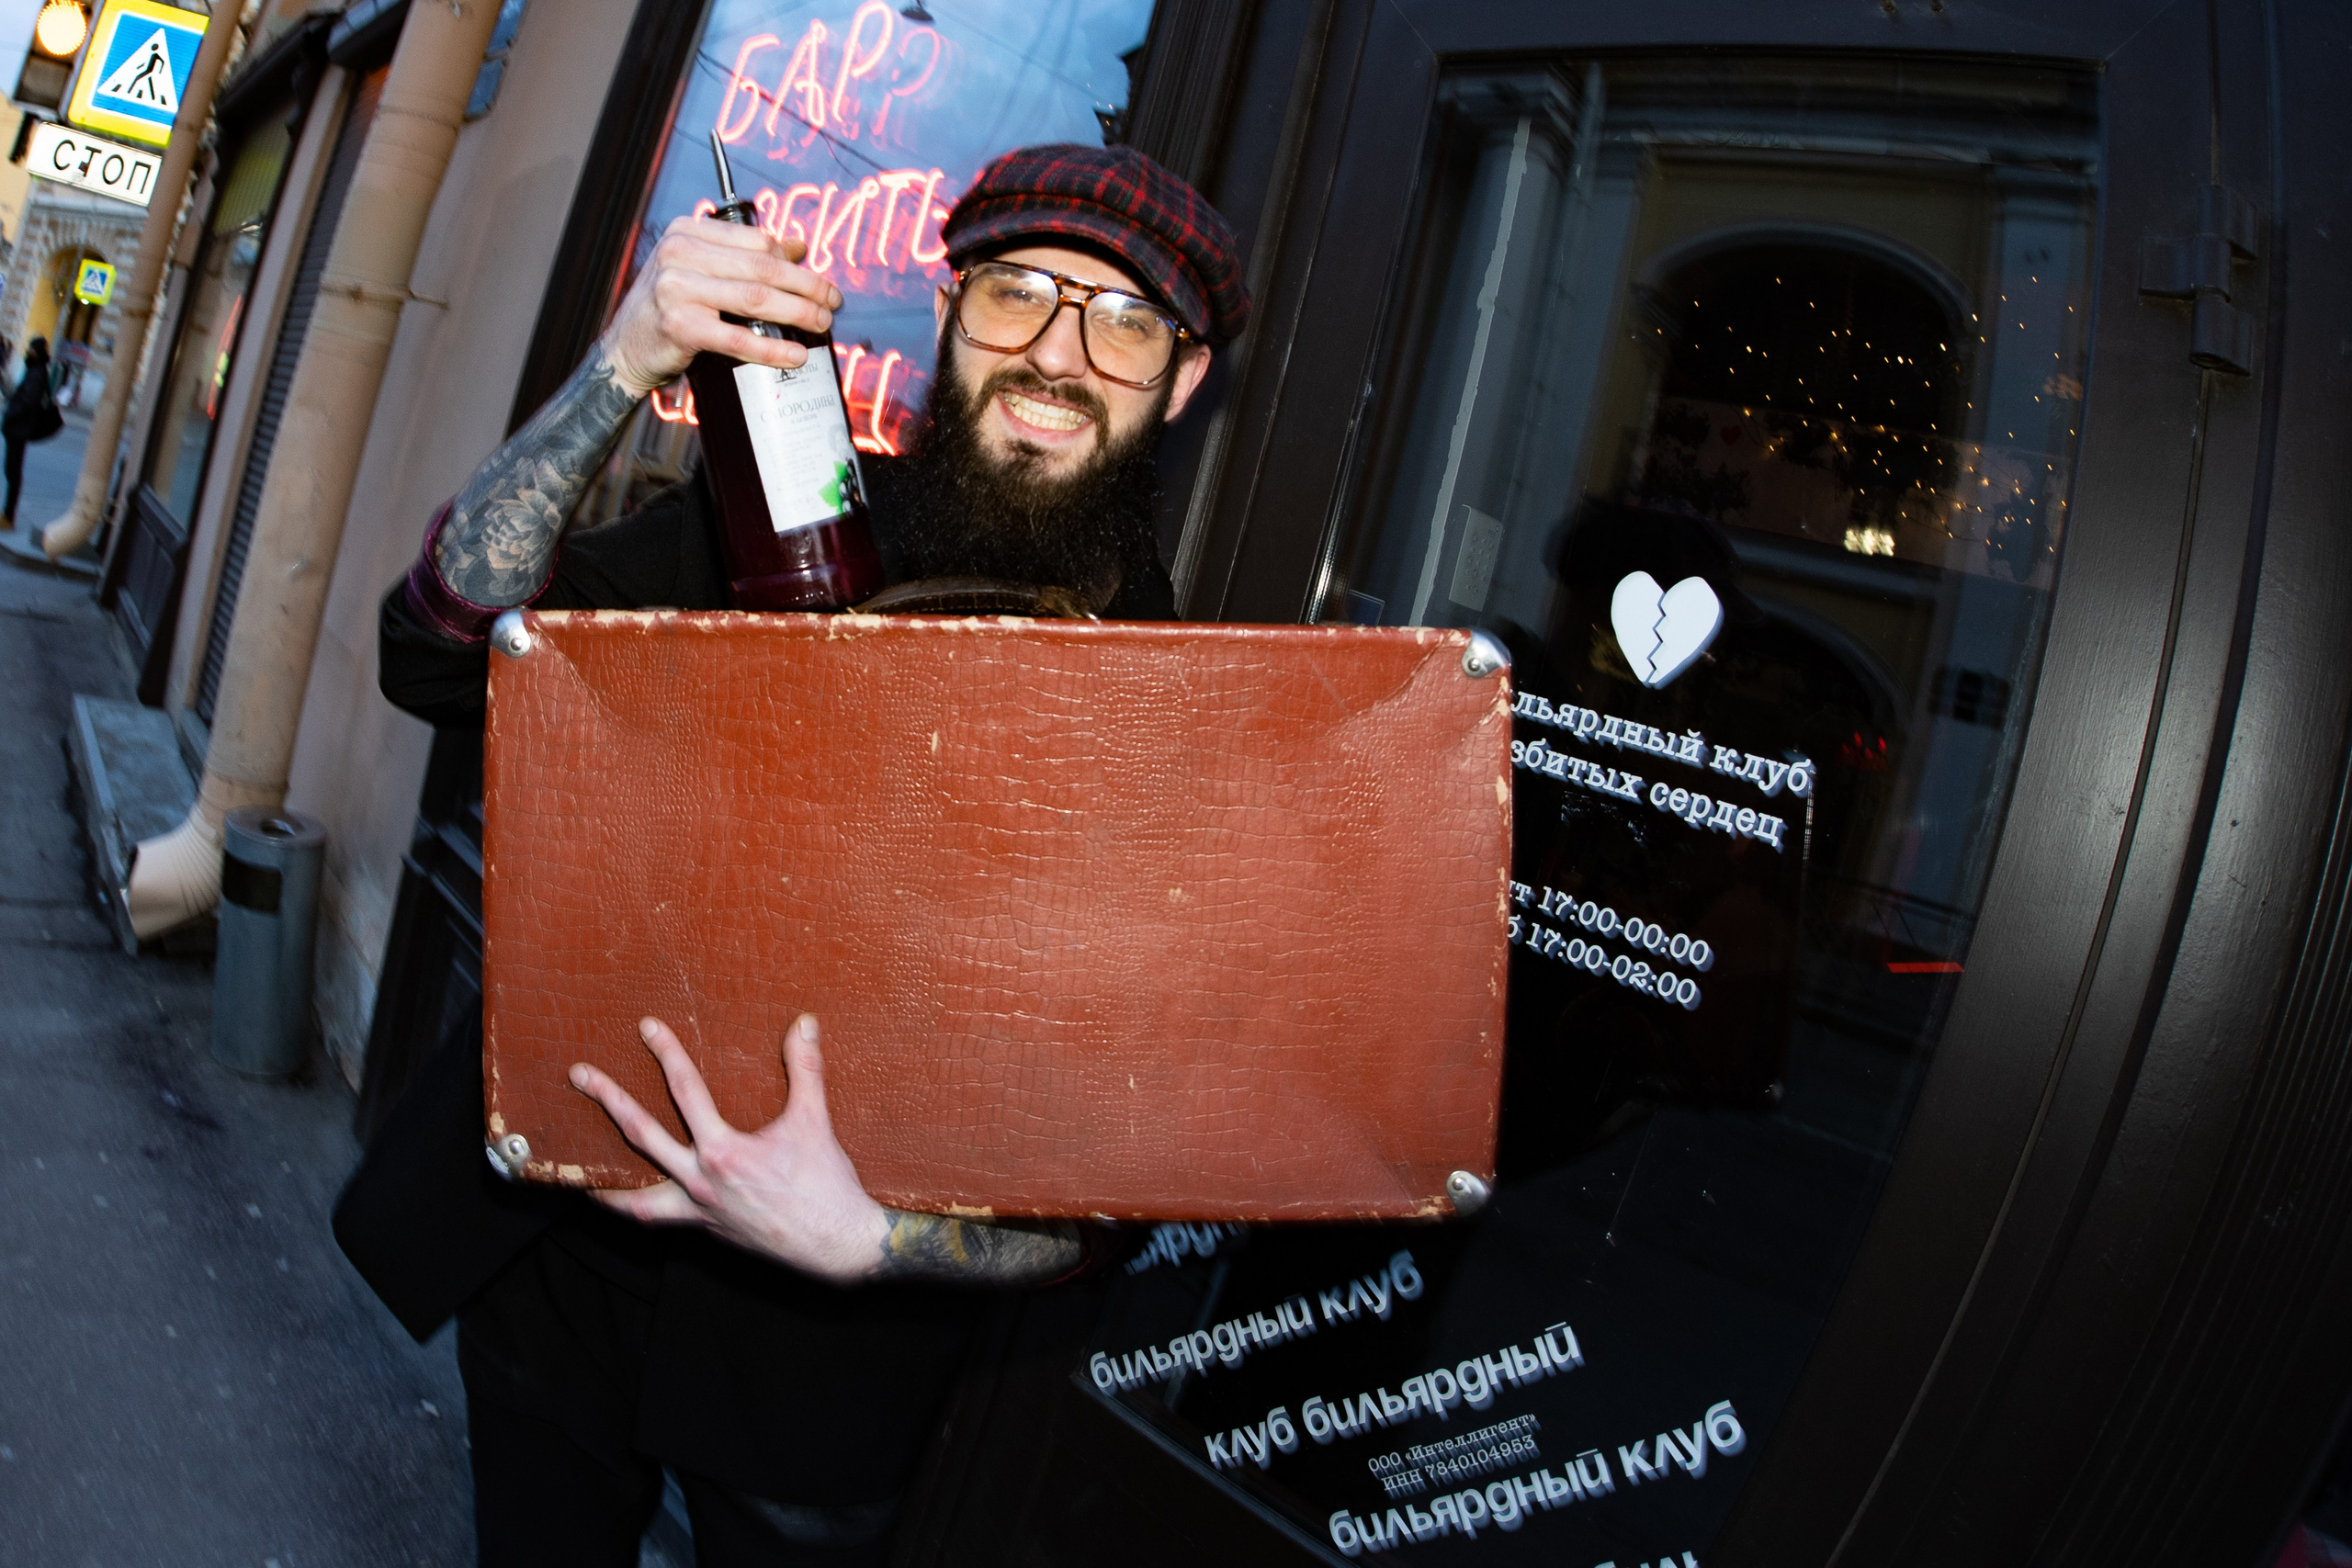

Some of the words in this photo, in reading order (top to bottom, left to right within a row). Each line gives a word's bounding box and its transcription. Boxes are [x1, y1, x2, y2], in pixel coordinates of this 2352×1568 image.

[53, 140, 152, 194] СТОП
[1510, 689, 1703, 763] льярдный
[1710, 745, 1812, 793] клуб
[1510, 739, 1643, 798] збитых
[1650, 782, 1783, 847] сердец
[1525, 922, 1697, 1005] 17:00-02:00
[1537, 886, 1710, 965] 17:00-00:00
[1090, 1293, 1314, 1390] бильярдный
[1320, 1250, 1423, 1319] клуб
[1204, 1405, 1295, 1463] клуб
[1302, 1321, 1580, 1437] бильярдный
[1405, 1414, 1536, 1461] «Интеллигент»
[1329, 1448, 1611, 1549] бильярдный
[1617, 1399, 1743, 1472] клуб
[1424, 1434, 1535, 1479] 7840104953
